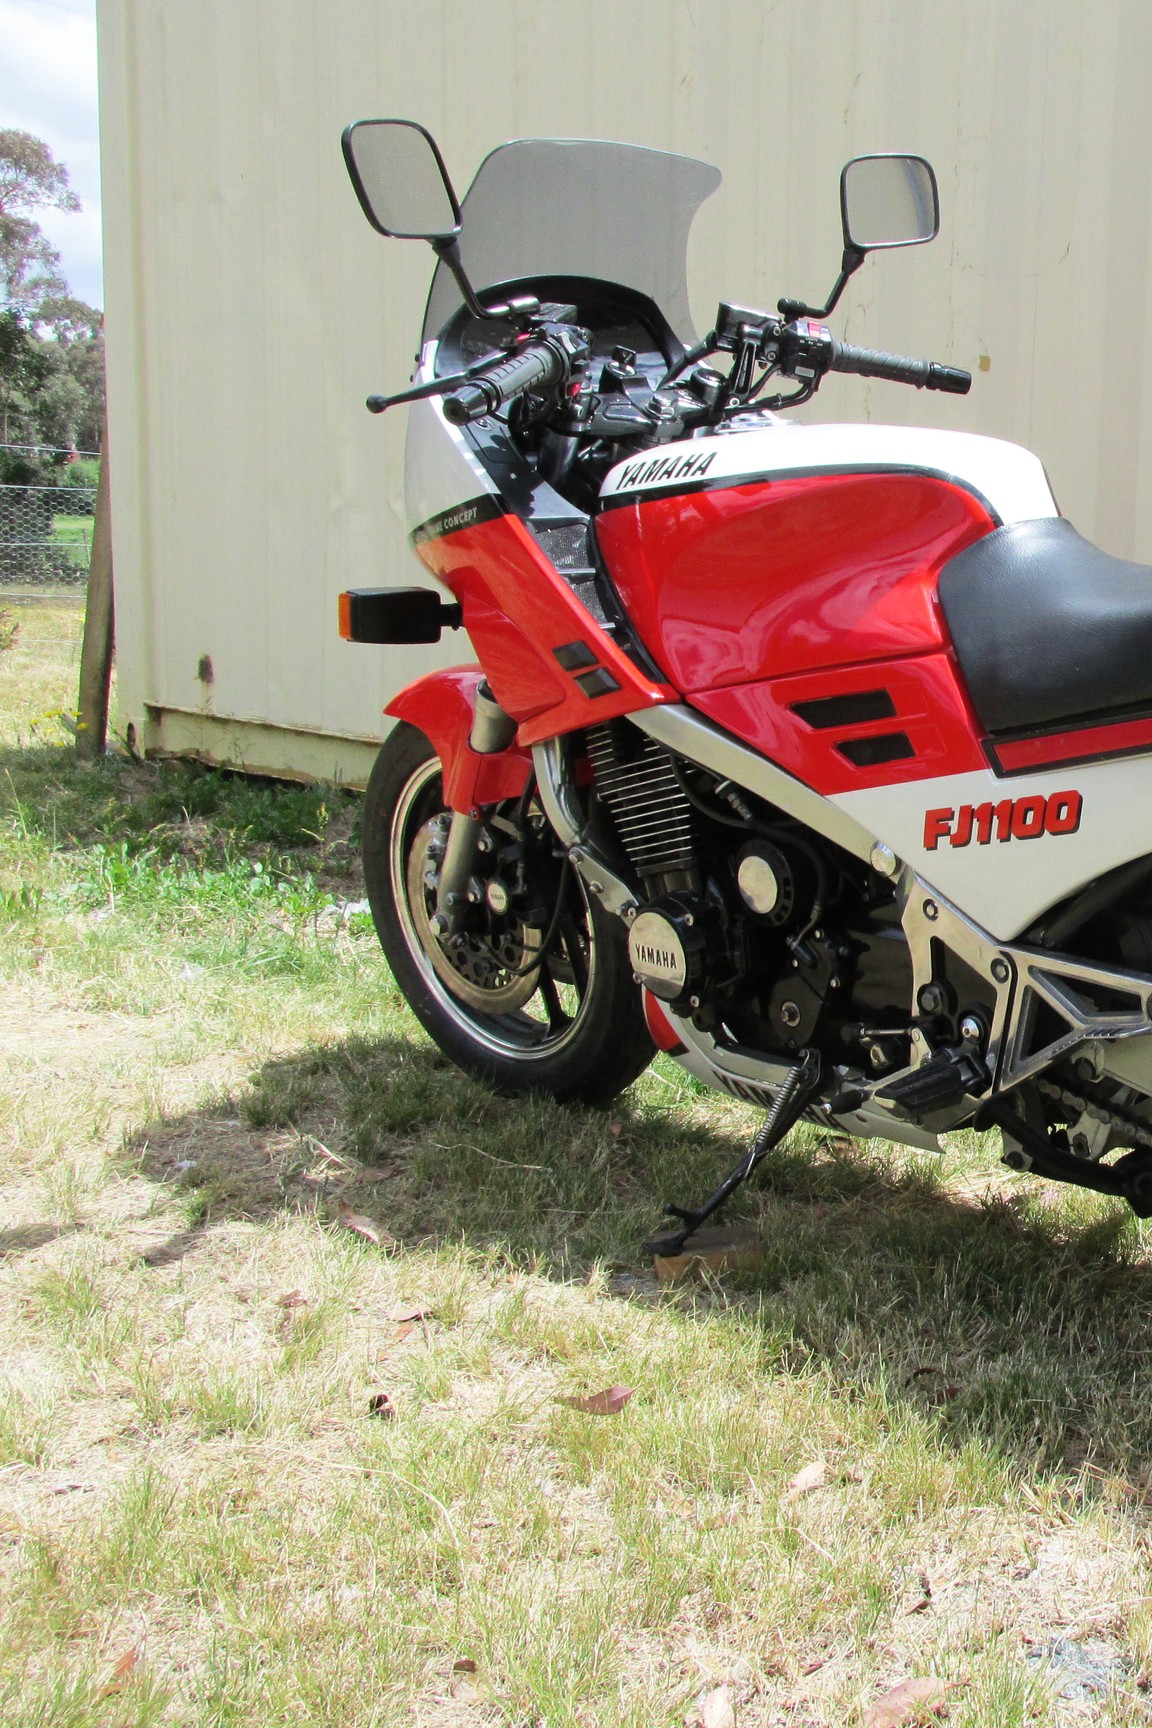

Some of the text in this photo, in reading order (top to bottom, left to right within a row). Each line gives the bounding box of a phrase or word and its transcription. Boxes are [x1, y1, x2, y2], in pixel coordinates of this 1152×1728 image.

[616, 452, 718, 490] YAMAHA
[443, 507, 478, 529] CONCEPT
[923, 789, 1083, 851] FJ1100
[635, 943, 677, 969] YAMAHA
